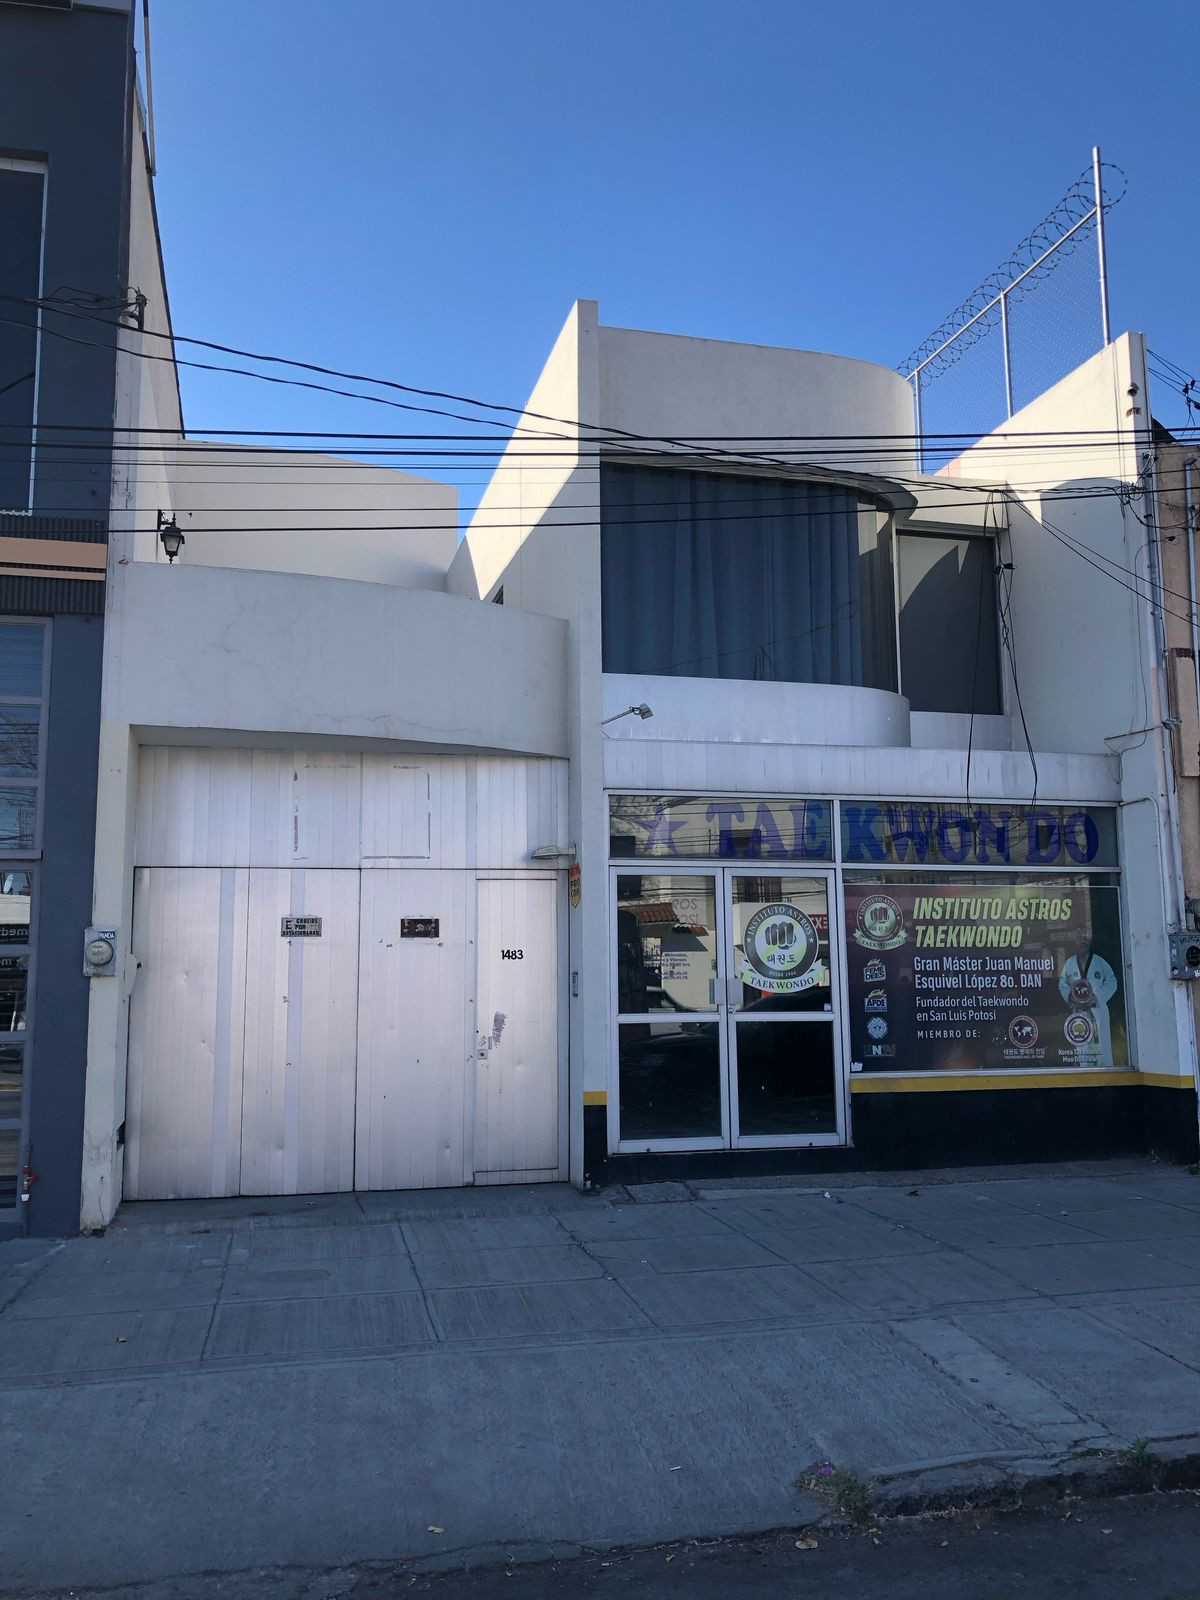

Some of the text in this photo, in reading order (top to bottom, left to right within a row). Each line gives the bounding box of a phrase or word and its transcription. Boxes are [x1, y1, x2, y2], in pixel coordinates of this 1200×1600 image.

[912, 897, 1072, 921] INSTITUTO ASTROS
[748, 906, 814, 936] INSTITUTO ASTROS
[915, 926, 1023, 948] TAEKWONDO
[501, 950, 524, 960] 1483
[914, 956, 1054, 971] Gran Máster Juan Manuel
[750, 976, 814, 989] TAEKWONDO
[915, 974, 1042, 991] Esquivel López 8o. DAN
[916, 995, 1029, 1007] Fundador del Taekwondo
[916, 1010, 996, 1021] en San Luis Potosí
[917, 1030, 981, 1038] MIEMBRO DE:
